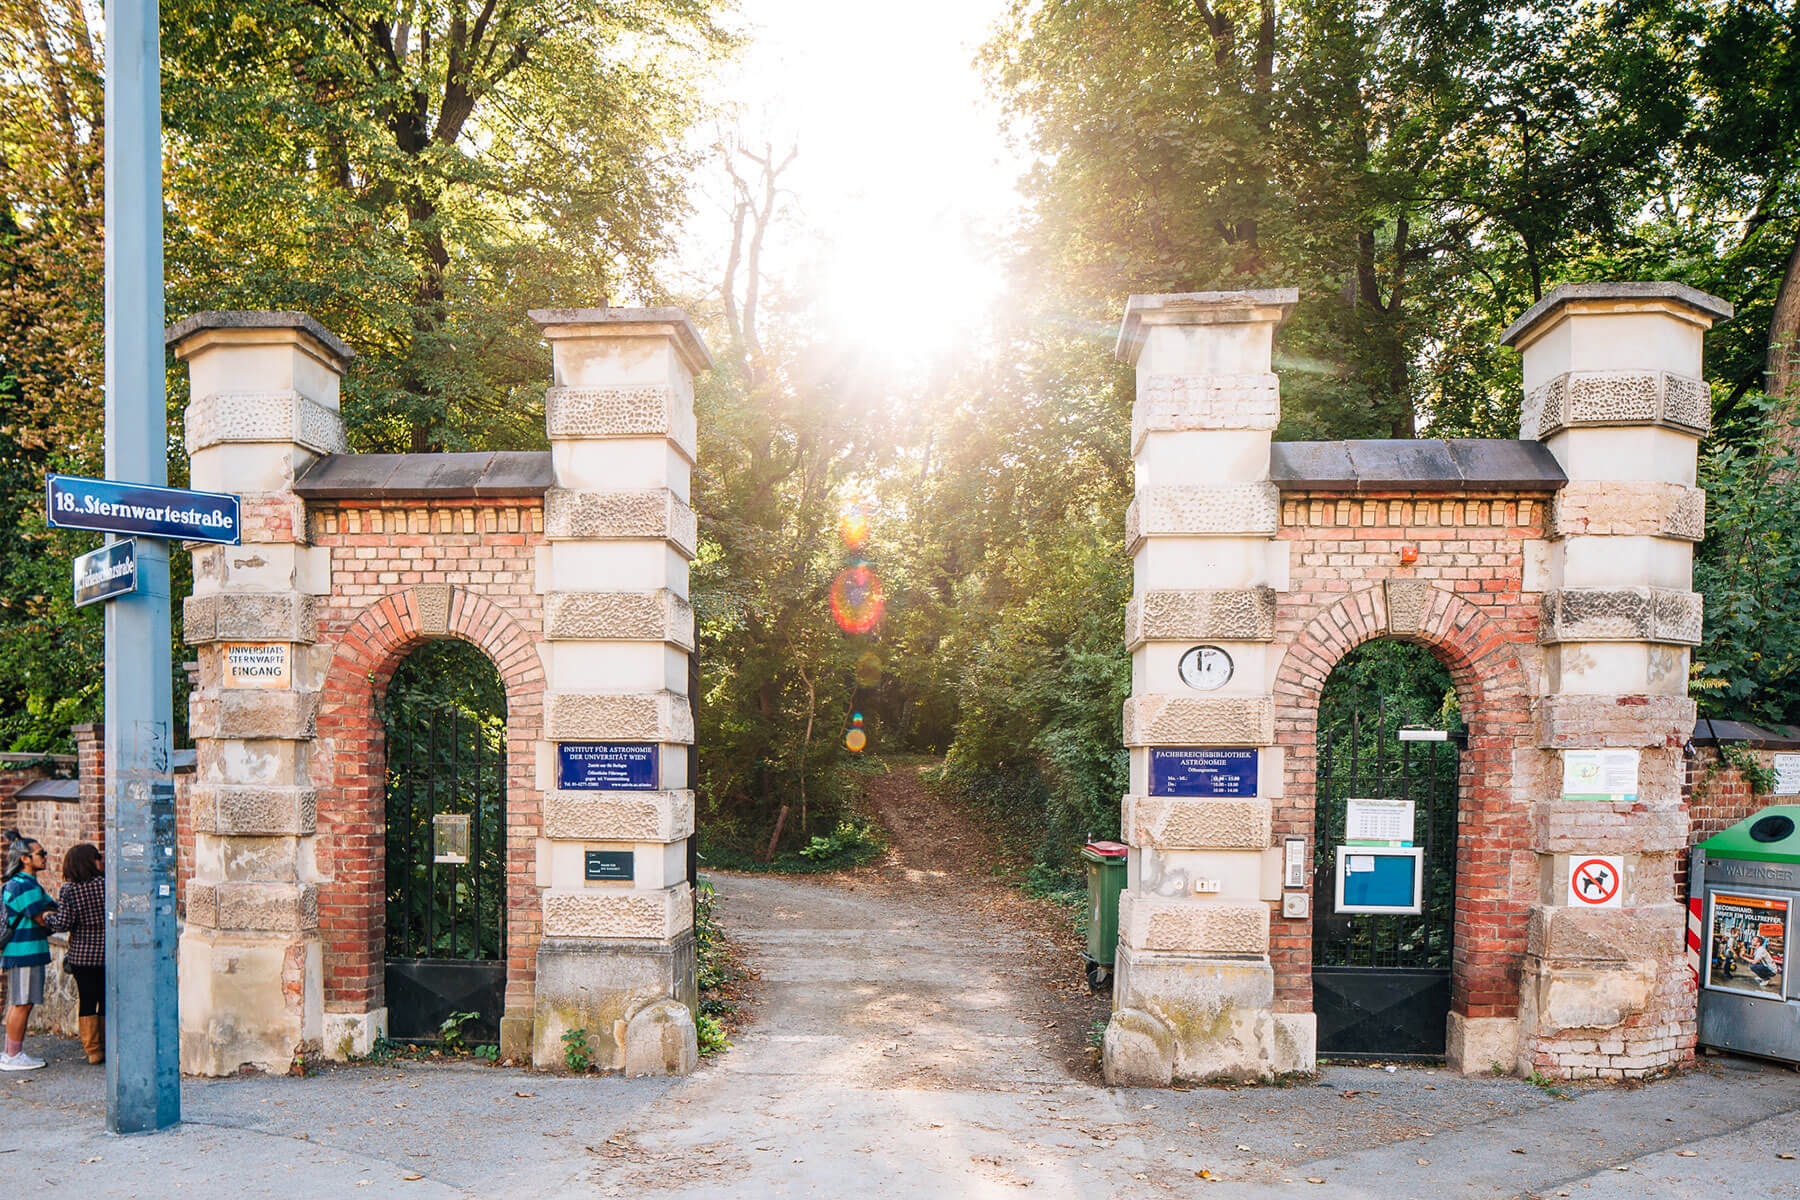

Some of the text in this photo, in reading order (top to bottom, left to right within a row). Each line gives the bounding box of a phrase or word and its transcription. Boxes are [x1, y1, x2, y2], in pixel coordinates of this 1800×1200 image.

[229, 656, 284, 664] STERNWARTE
[232, 667, 282, 677] EINGANG
[595, 745, 608, 753] FÜR
[584, 753, 628, 761] UNIVERSITÄT
[1156, 751, 1252, 759] FACHBEREICHSBIBLIOTHEK
[1725, 863, 1793, 881] WAIZINGER
